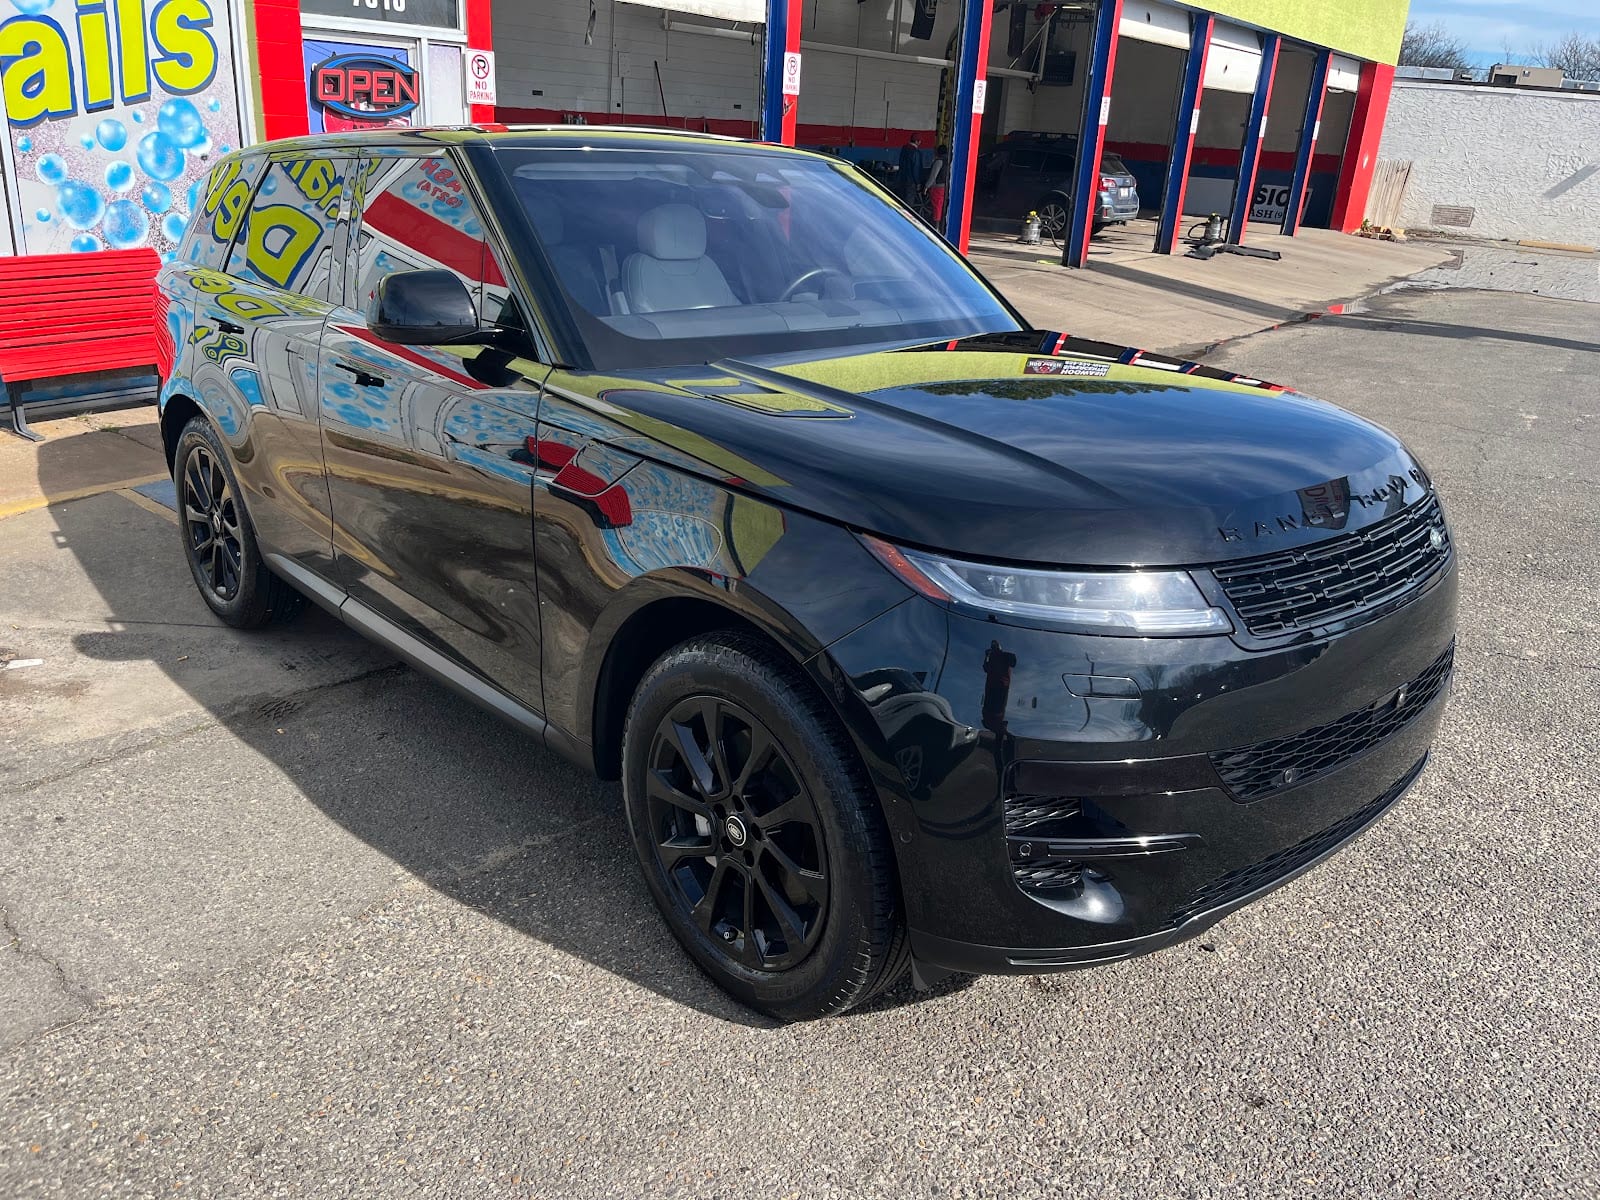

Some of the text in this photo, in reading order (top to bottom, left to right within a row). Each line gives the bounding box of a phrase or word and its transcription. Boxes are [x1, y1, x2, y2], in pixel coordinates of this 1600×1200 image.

[0, 0, 219, 129] ails
[317, 68, 419, 104] OPEN
[470, 90, 494, 102] PARKING
[475, 80, 488, 90] NO
